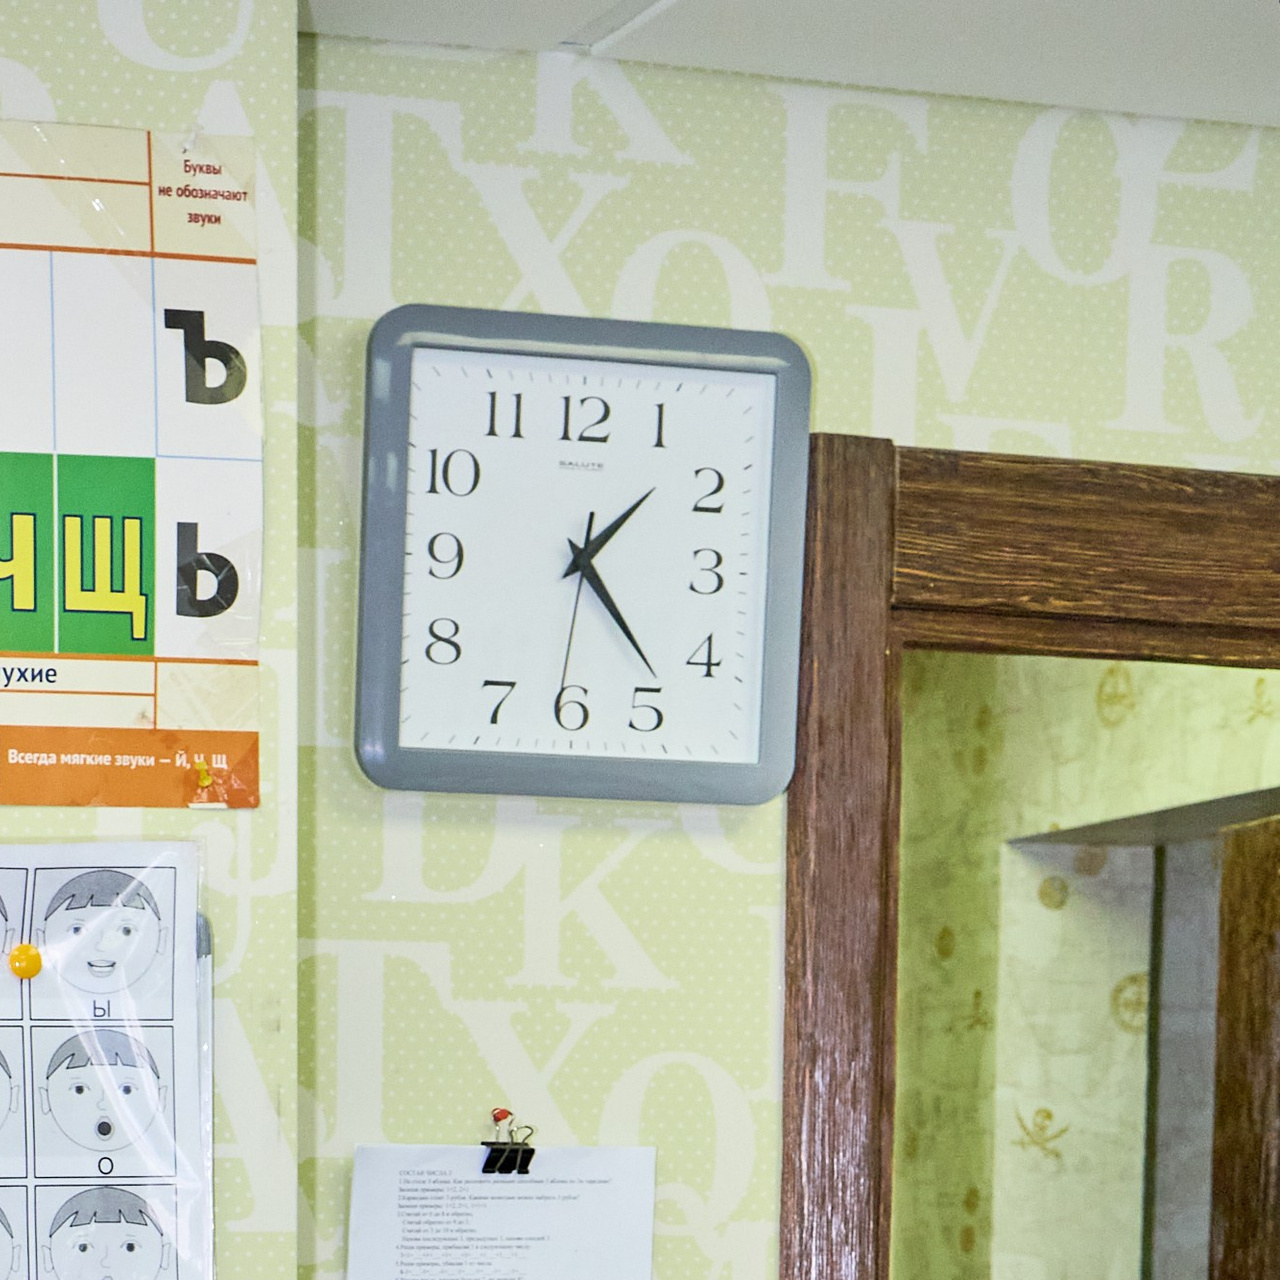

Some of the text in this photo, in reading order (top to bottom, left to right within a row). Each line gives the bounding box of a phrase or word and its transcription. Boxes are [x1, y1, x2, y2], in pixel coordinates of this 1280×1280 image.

[183, 159, 222, 176] Буквы
[158, 184, 249, 202] не обозначают
[187, 213, 222, 227] звуки
[485, 391, 525, 439] 11
[559, 395, 612, 443] 12
[652, 403, 666, 448] 1
[425, 448, 481, 496] 10
[692, 467, 726, 514] 2
[427, 533, 465, 579] 9
[689, 548, 725, 595] 3
[424, 618, 462, 665] 8
[685, 633, 722, 678] 4
[481, 680, 518, 725] 7
[553, 685, 590, 731] 6
[628, 687, 665, 732] 5
[8, 749, 56, 766] Всегда
[60, 752, 111, 767] мягкие
[114, 755, 155, 770] звуки
[175, 750, 191, 769] Й,
[193, 754, 207, 769] Ч
[93, 999, 111, 1018] Ы
[97, 1156, 114, 1175] О
